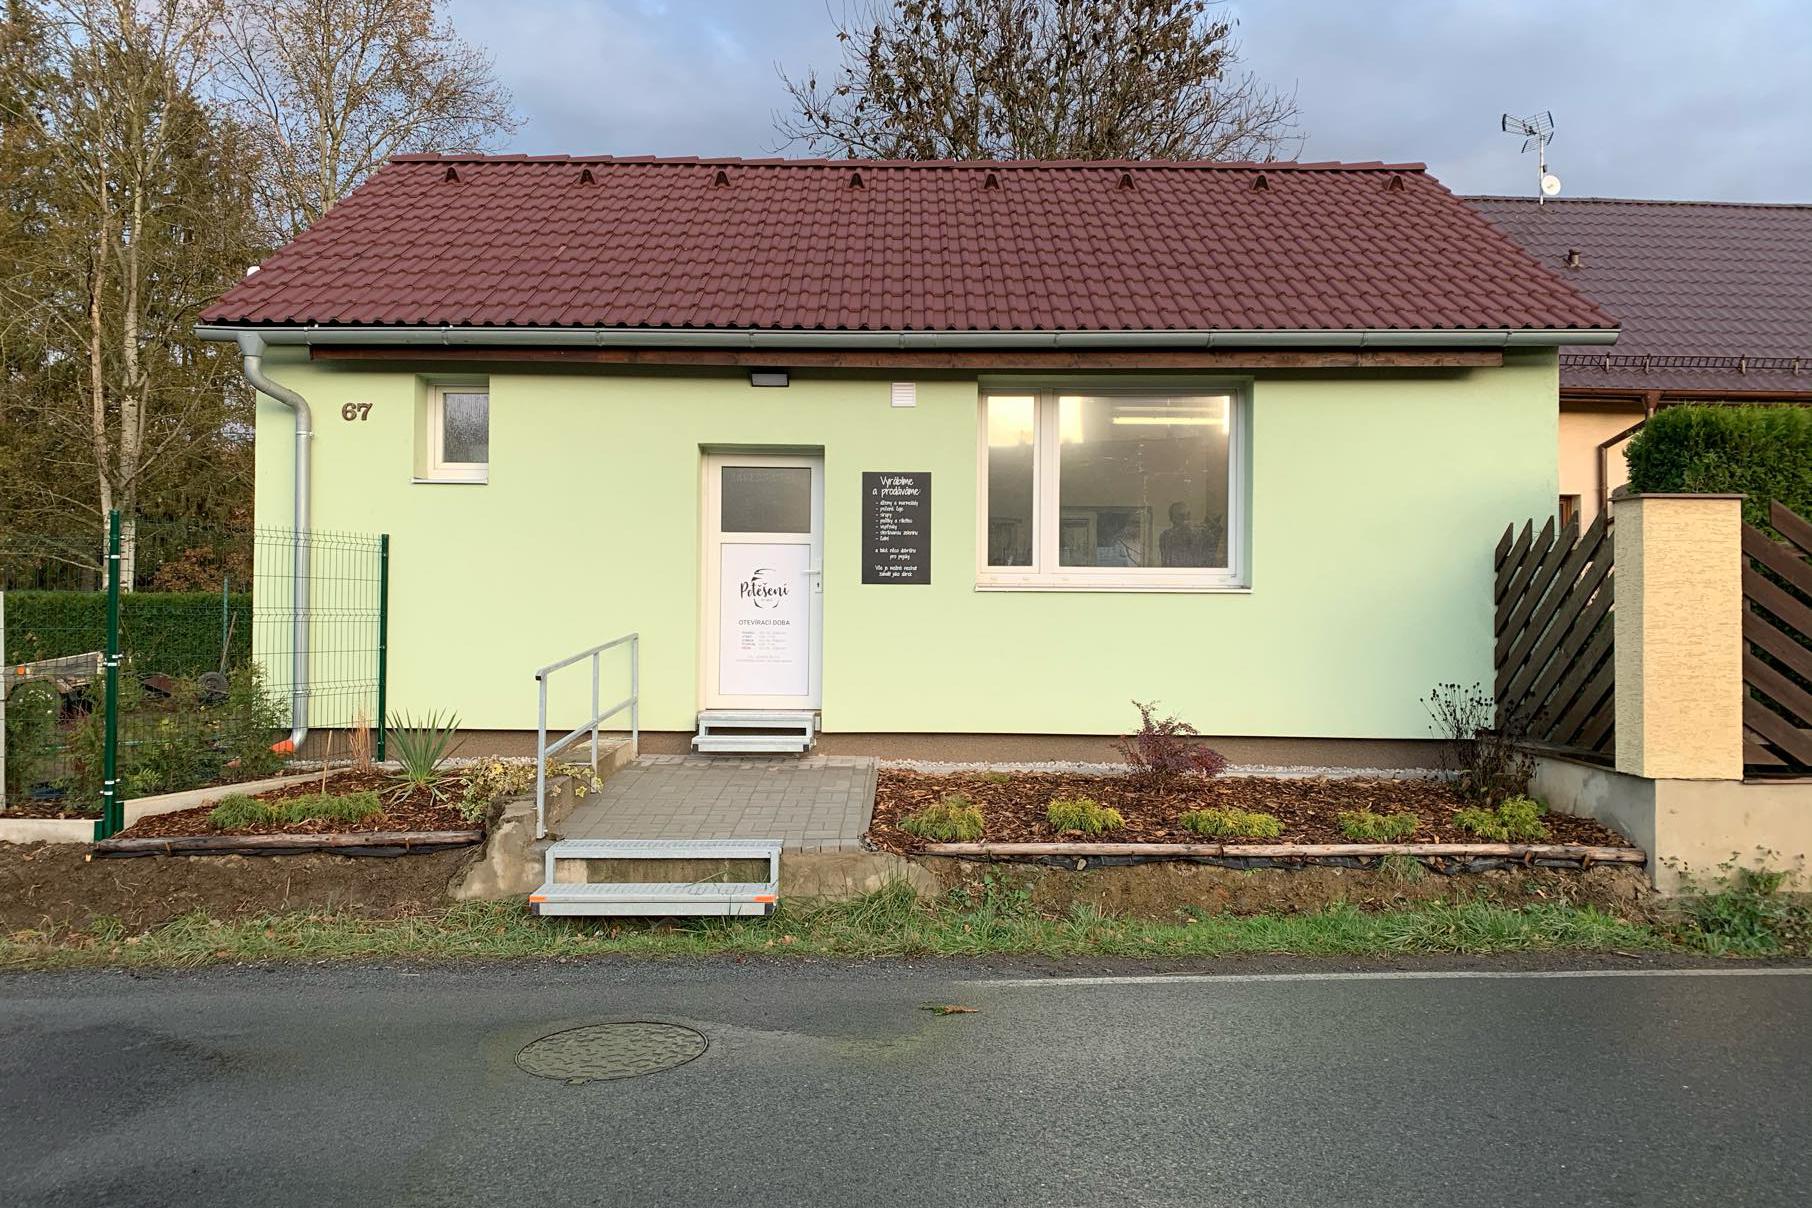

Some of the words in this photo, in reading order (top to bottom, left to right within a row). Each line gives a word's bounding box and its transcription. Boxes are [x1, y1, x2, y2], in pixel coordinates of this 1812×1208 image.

[342, 402, 373, 421] 67
[872, 488, 878, 496] a
[740, 582, 788, 598] Potěšení
